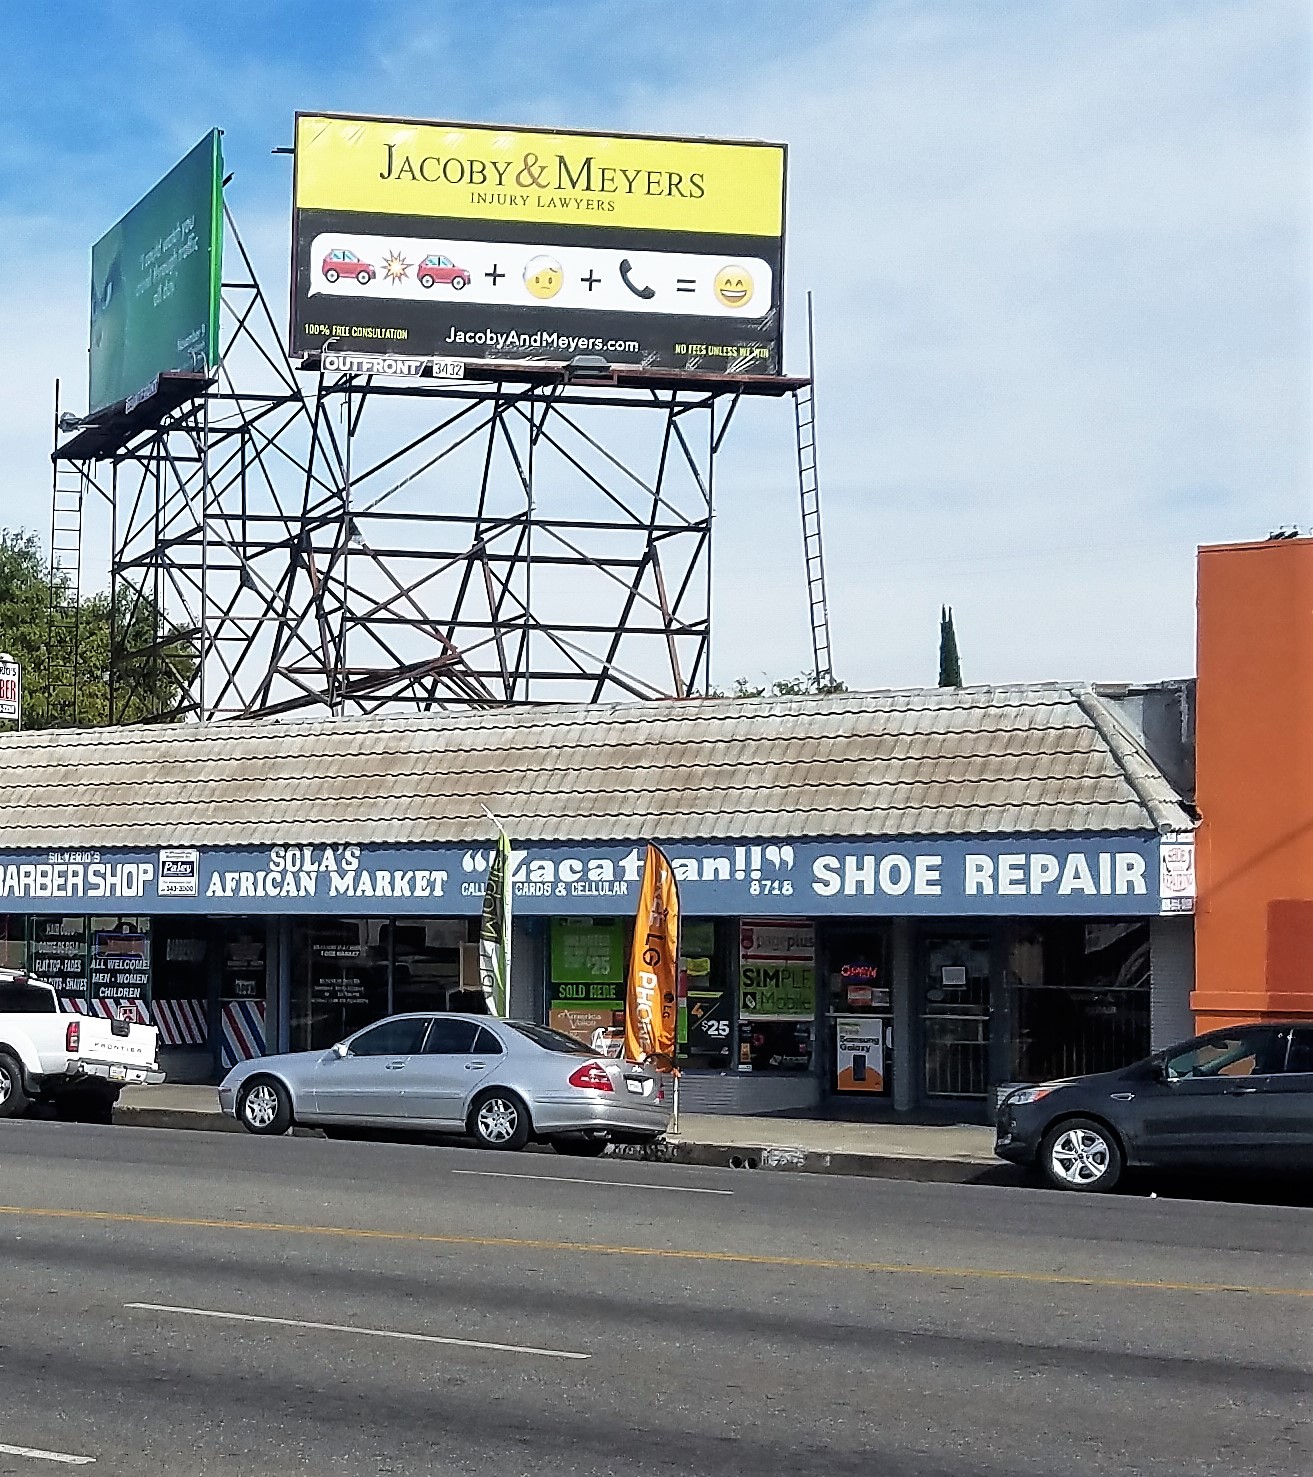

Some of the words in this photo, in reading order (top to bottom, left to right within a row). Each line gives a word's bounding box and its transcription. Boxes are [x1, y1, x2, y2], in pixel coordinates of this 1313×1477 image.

[470, 192, 530, 206] INJURY
[537, 195, 615, 212] LAWYERS
[304, 323, 330, 336] 100%
[332, 325, 350, 337] FREE
[351, 326, 408, 340] CONSULTATION
[444, 327, 639, 353] JacobyAndMeyers.com
[675, 343, 687, 355] NO
[688, 344, 707, 355] FEES
[708, 345, 738, 357] UNLESS
[435, 363, 462, 376] 3432
[49, 851, 100, 863] SILVERIO'S
[270, 846, 361, 872] SOLA'S
[165, 861, 191, 874] Paley
[812, 855, 943, 896] SHOE
[965, 852, 1148, 896] REPAIR
[205, 871, 317, 897] AFRICAN
[329, 871, 448, 897] MARKET
[515, 882, 551, 896] CARDS
[555, 882, 567, 896] &
[571, 882, 628, 896] CELLULAR
[750, 880, 794, 895] 8718
[642, 932, 664, 967] LG
[64, 959, 81, 971] FADES
[90, 959, 105, 969] ALL
[66, 978, 87, 990] SHAVES
[92, 973, 110, 983] MEN
[117, 973, 148, 983] WOMEN
[743, 968, 811, 988] SIMPLE
[99, 987, 140, 997] CHILDREN
[559, 985, 585, 998] SOLD
[590, 985, 616, 998] HERE
[761, 991, 811, 1009] Mobile
[662, 1005, 671, 1019] LG
[701, 1020, 729, 1035] $25
[840, 1036, 879, 1045] Samsung
[95, 1043, 141, 1053] FRONTIER
[840, 1044, 871, 1053] Galaxy
